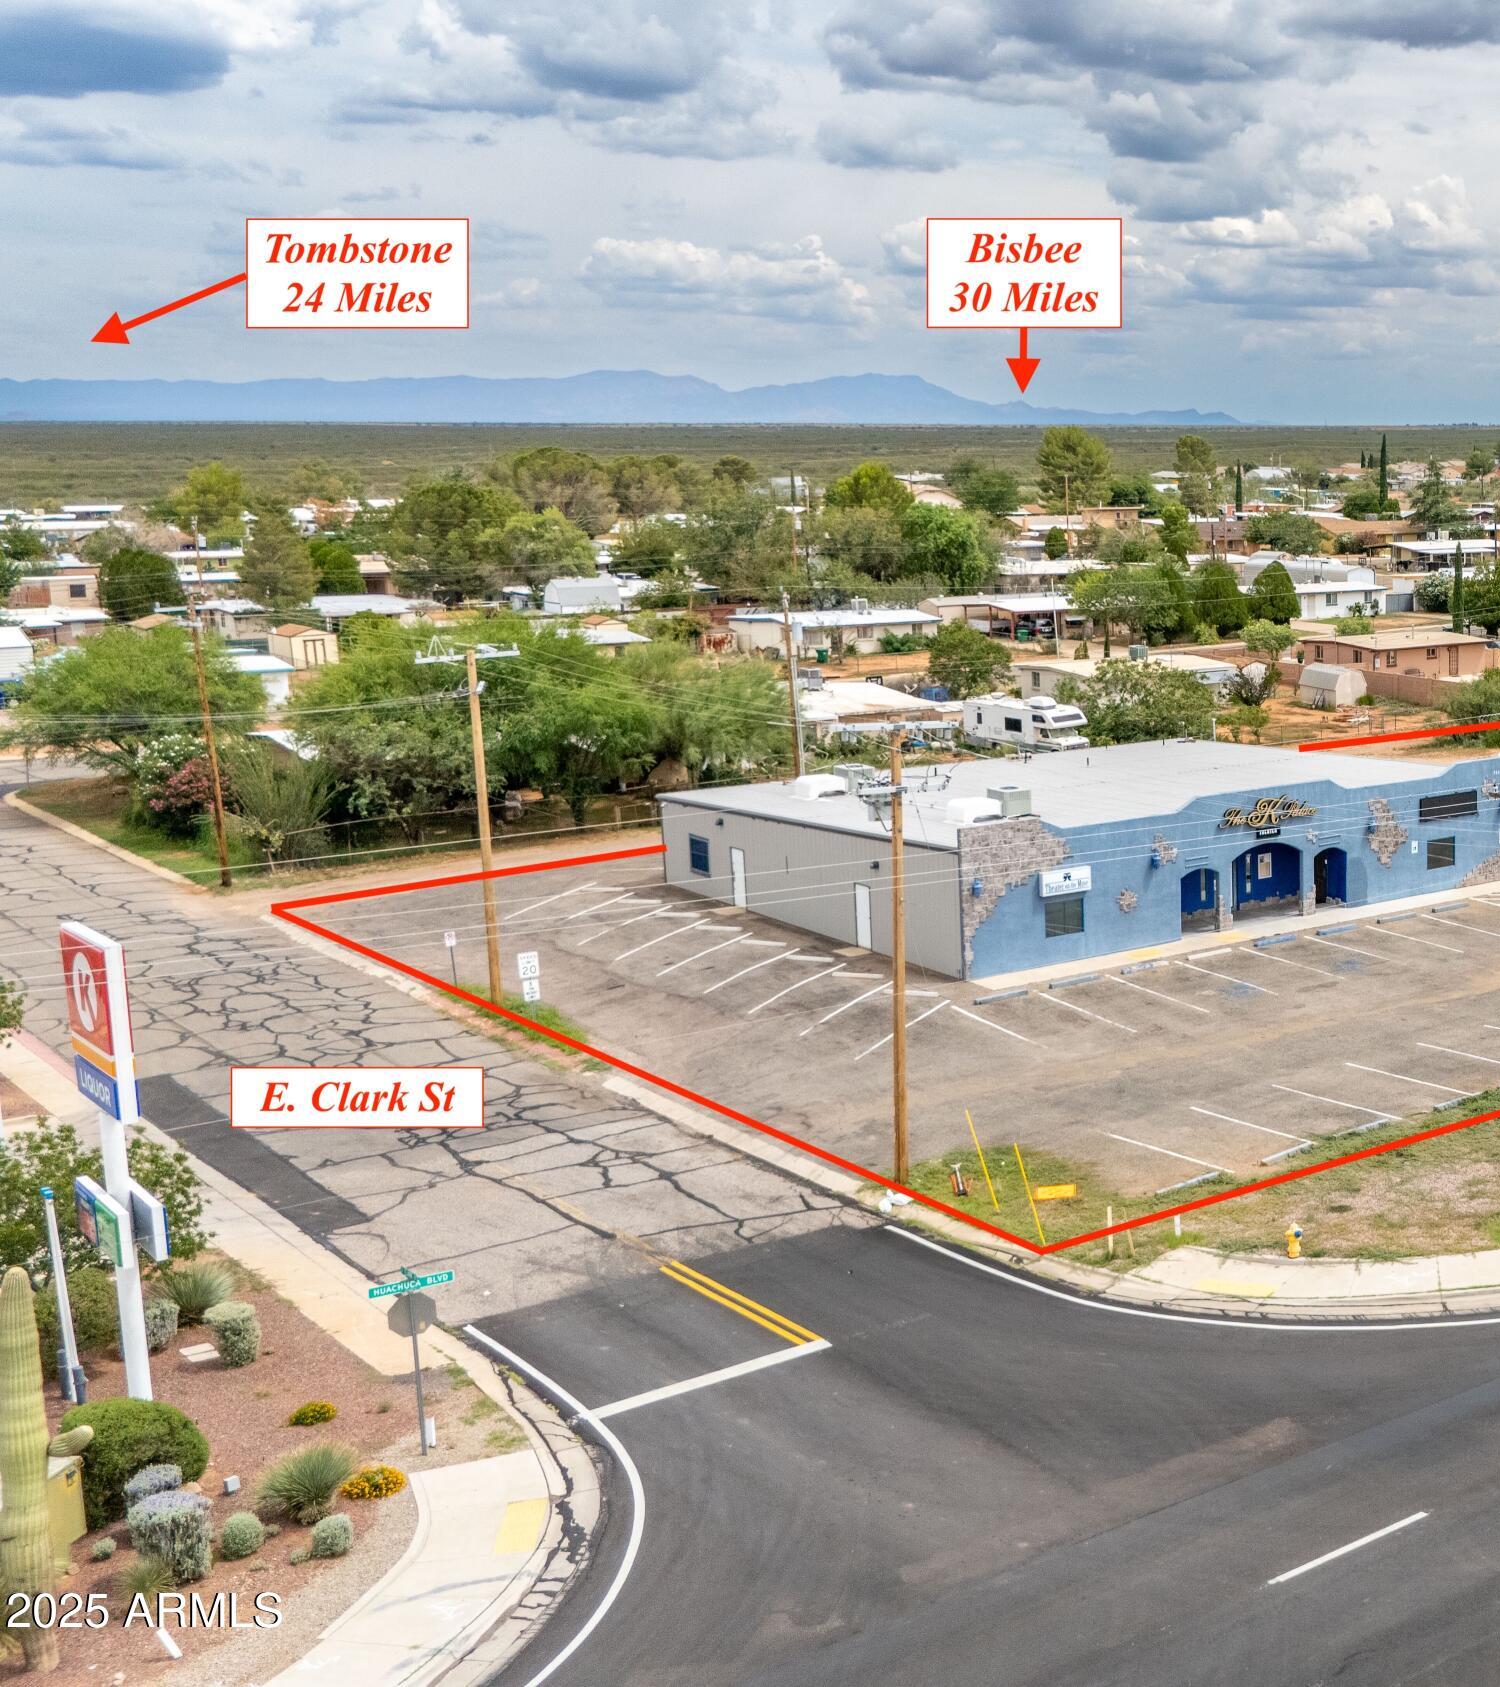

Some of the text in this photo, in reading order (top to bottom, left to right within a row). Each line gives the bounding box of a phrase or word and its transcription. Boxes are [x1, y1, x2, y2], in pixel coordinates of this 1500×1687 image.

[1218, 795, 1319, 829] The K Palace
[522, 965, 537, 976] 20
[79, 1067, 112, 1108] LIQUOR
[373, 1273, 449, 1296] HUACHUCA BLVD
